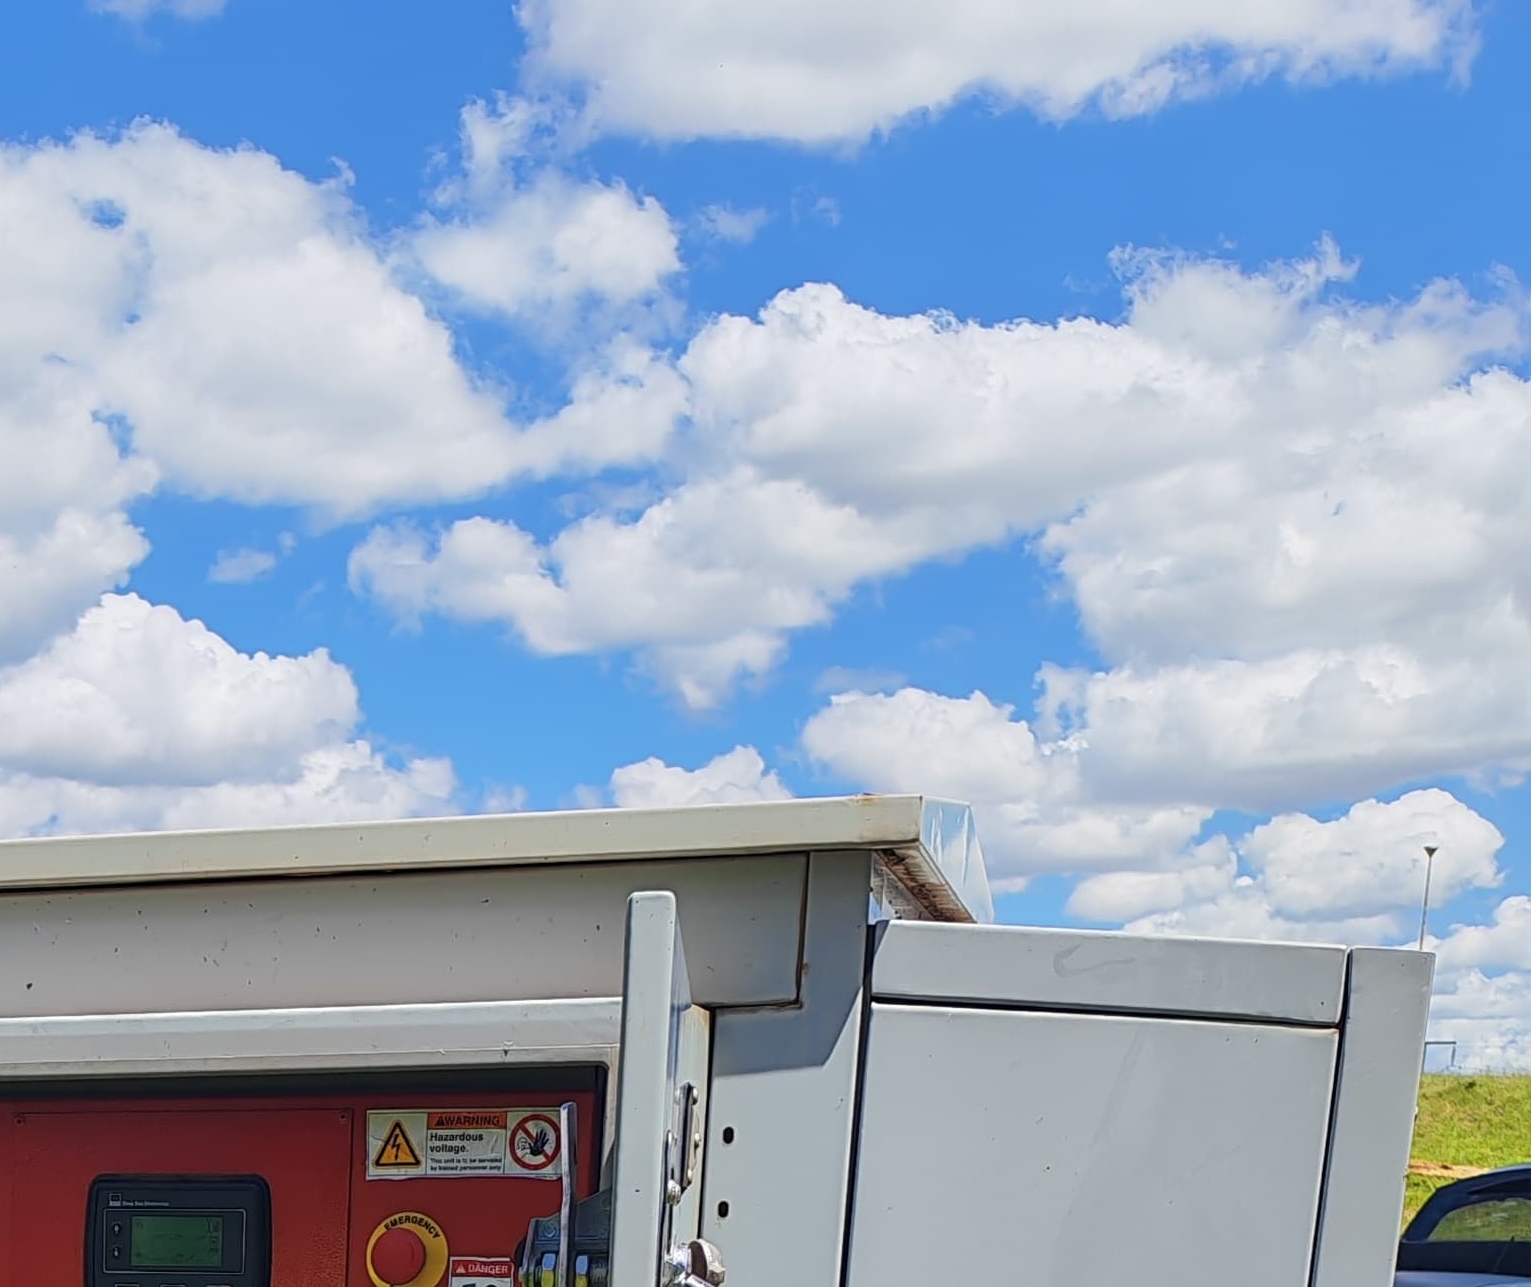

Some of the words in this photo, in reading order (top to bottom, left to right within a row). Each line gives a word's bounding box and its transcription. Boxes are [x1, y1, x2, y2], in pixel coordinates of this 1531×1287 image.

[444, 1114, 500, 1127] WARNING
[430, 1132, 484, 1141] Hazardous
[383, 1215, 441, 1239] EMERGENCY
[468, 1263, 509, 1275] DANGER
